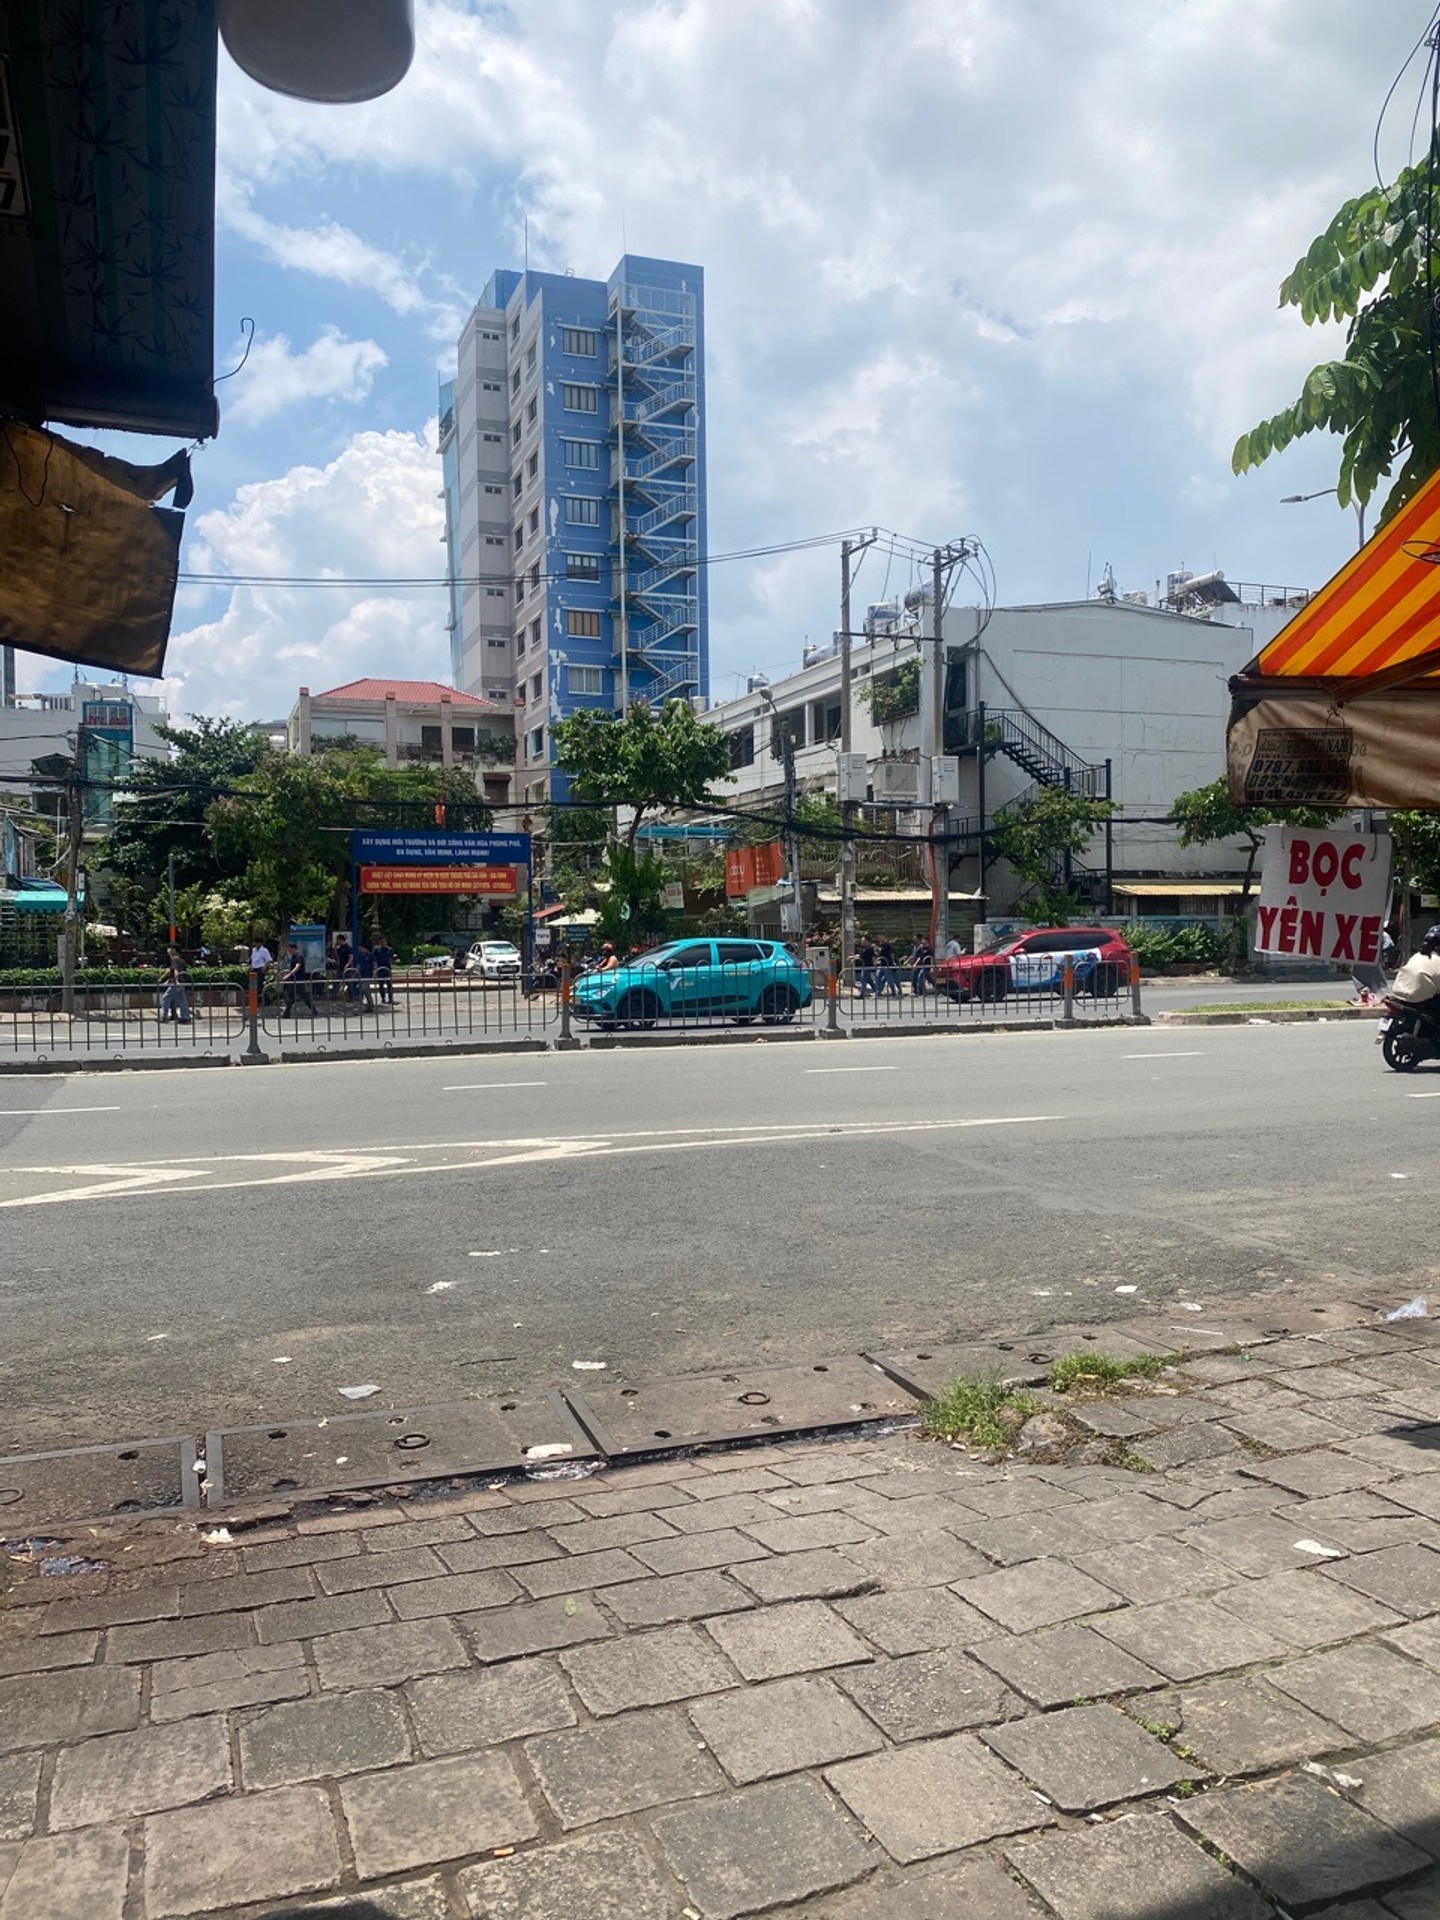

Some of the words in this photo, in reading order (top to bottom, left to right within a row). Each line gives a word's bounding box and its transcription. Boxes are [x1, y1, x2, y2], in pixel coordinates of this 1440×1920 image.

[362, 837, 373, 846] XÂY
[374, 838, 390, 847] DỰNG
[1288, 840, 1366, 896] BỌC
[1258, 895, 1324, 956] YÊN
[1330, 913, 1382, 962] XE
